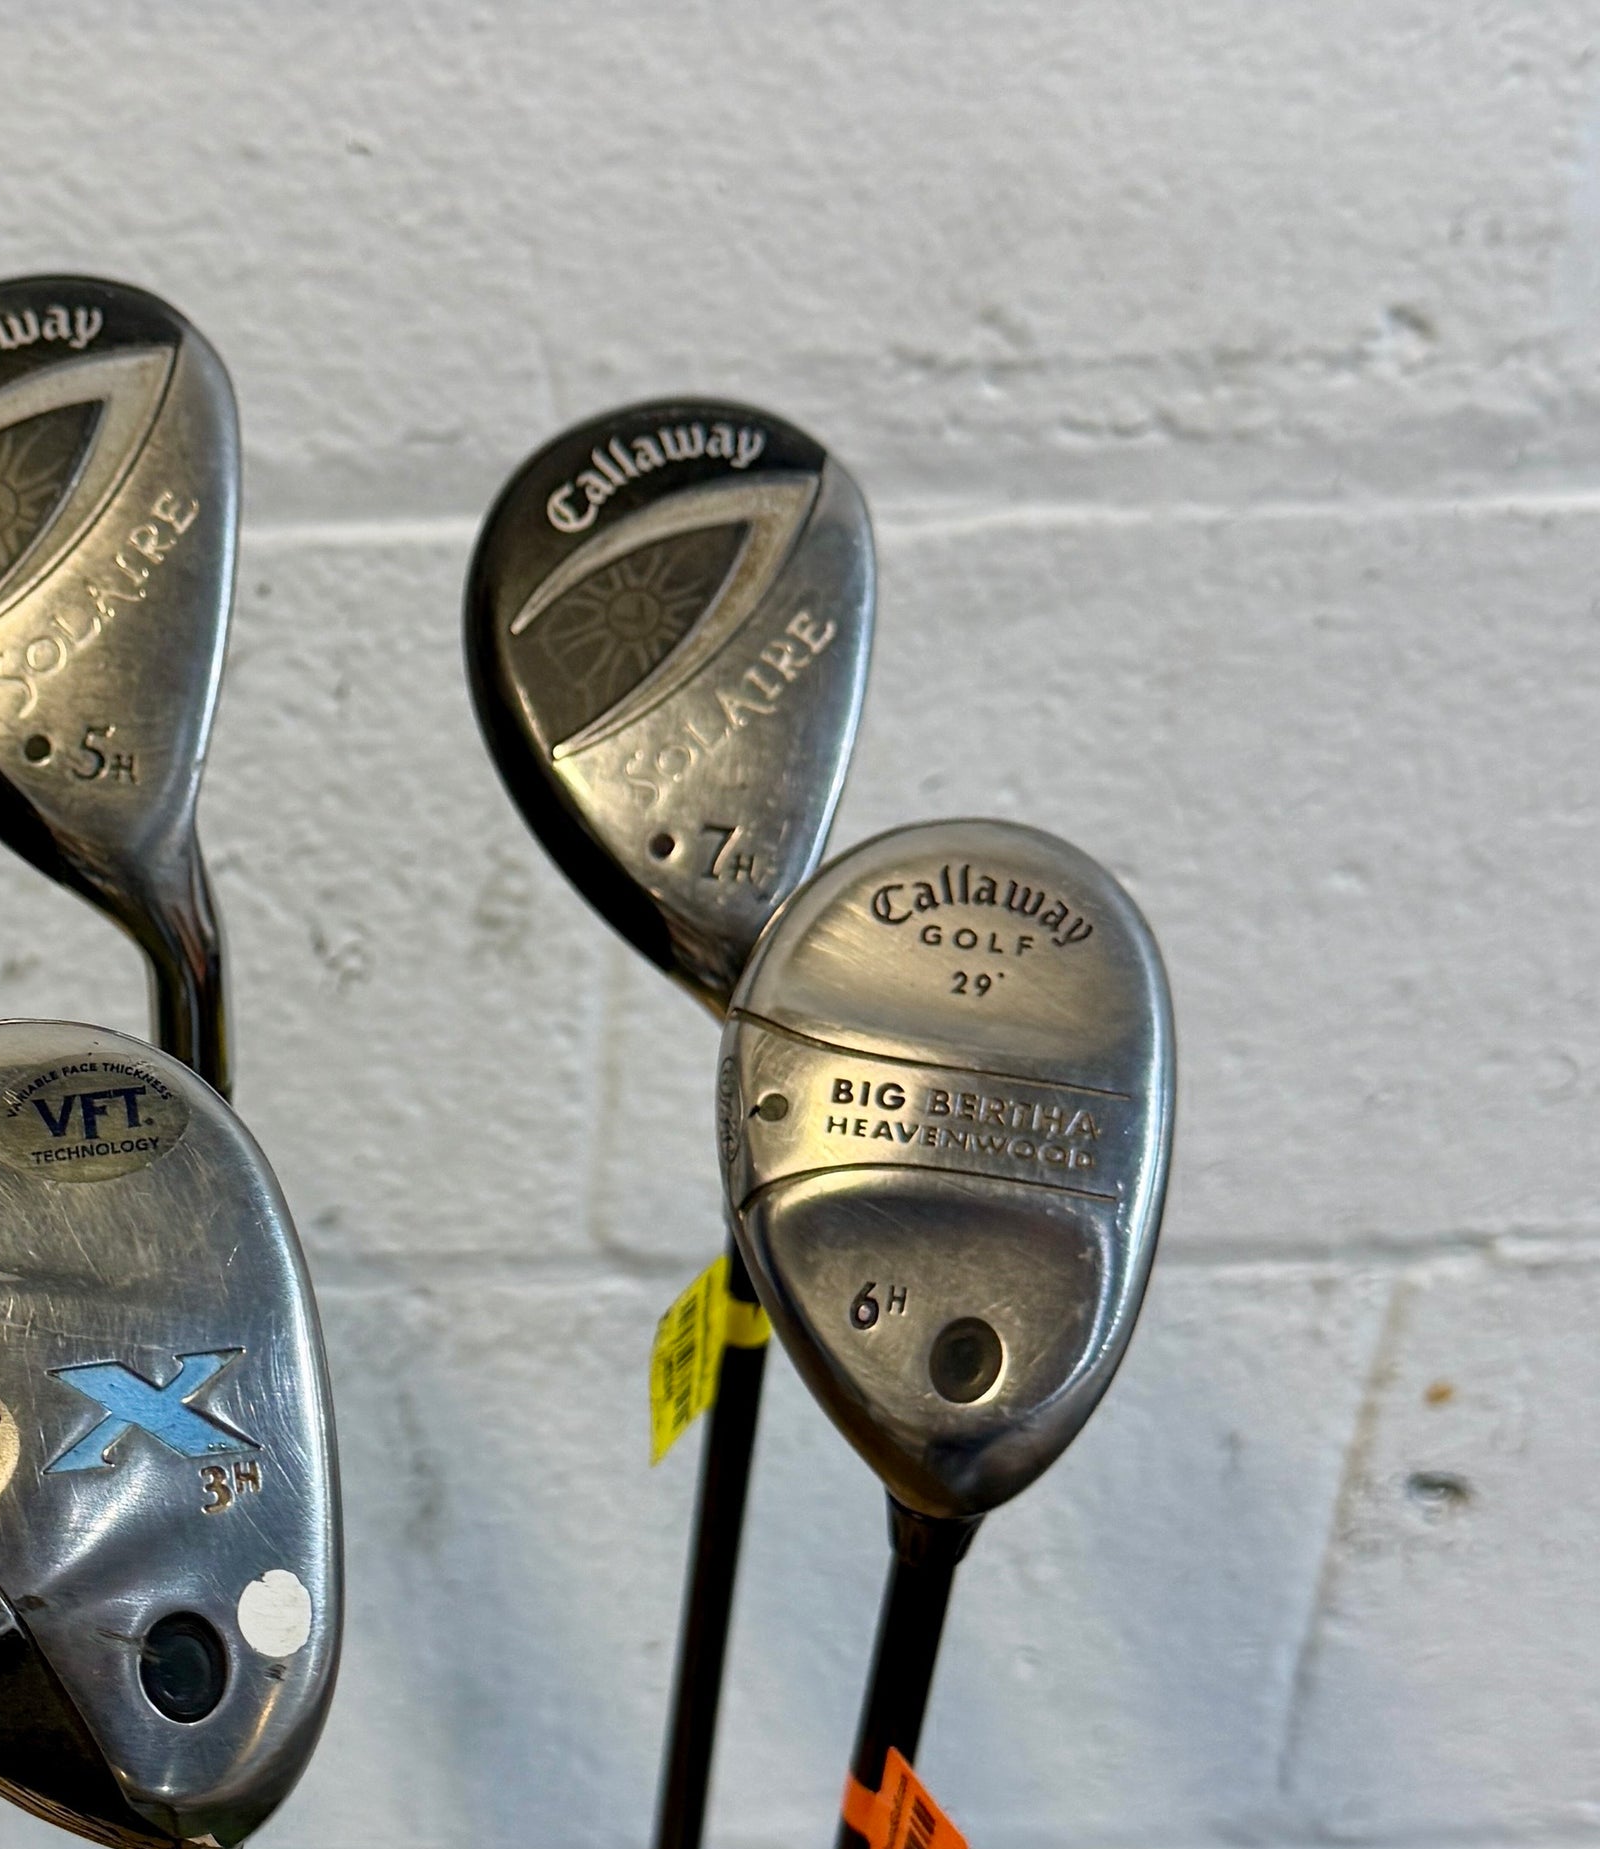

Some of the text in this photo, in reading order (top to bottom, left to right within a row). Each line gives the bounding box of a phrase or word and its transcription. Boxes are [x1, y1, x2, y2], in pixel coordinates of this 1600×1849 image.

[547, 422, 767, 533] Callaway
[626, 610, 838, 809] SOLAIRE
[72, 724, 138, 784] 5H
[701, 825, 761, 884] 7H
[870, 865, 1094, 947] Callaway
[919, 925, 1035, 955] GOLF
[7, 1062, 174, 1118] VARIABLE FACE THICKNESS
[831, 1078, 1102, 1141] BIG BERTHA
[31, 1136, 160, 1165] TECHNOLOGY
[827, 1115, 1096, 1169] HEAVENWOOD
[851, 1282, 908, 1331] 6H
[41, 1346, 264, 1475] X
[199, 1460, 263, 1514] 3H
